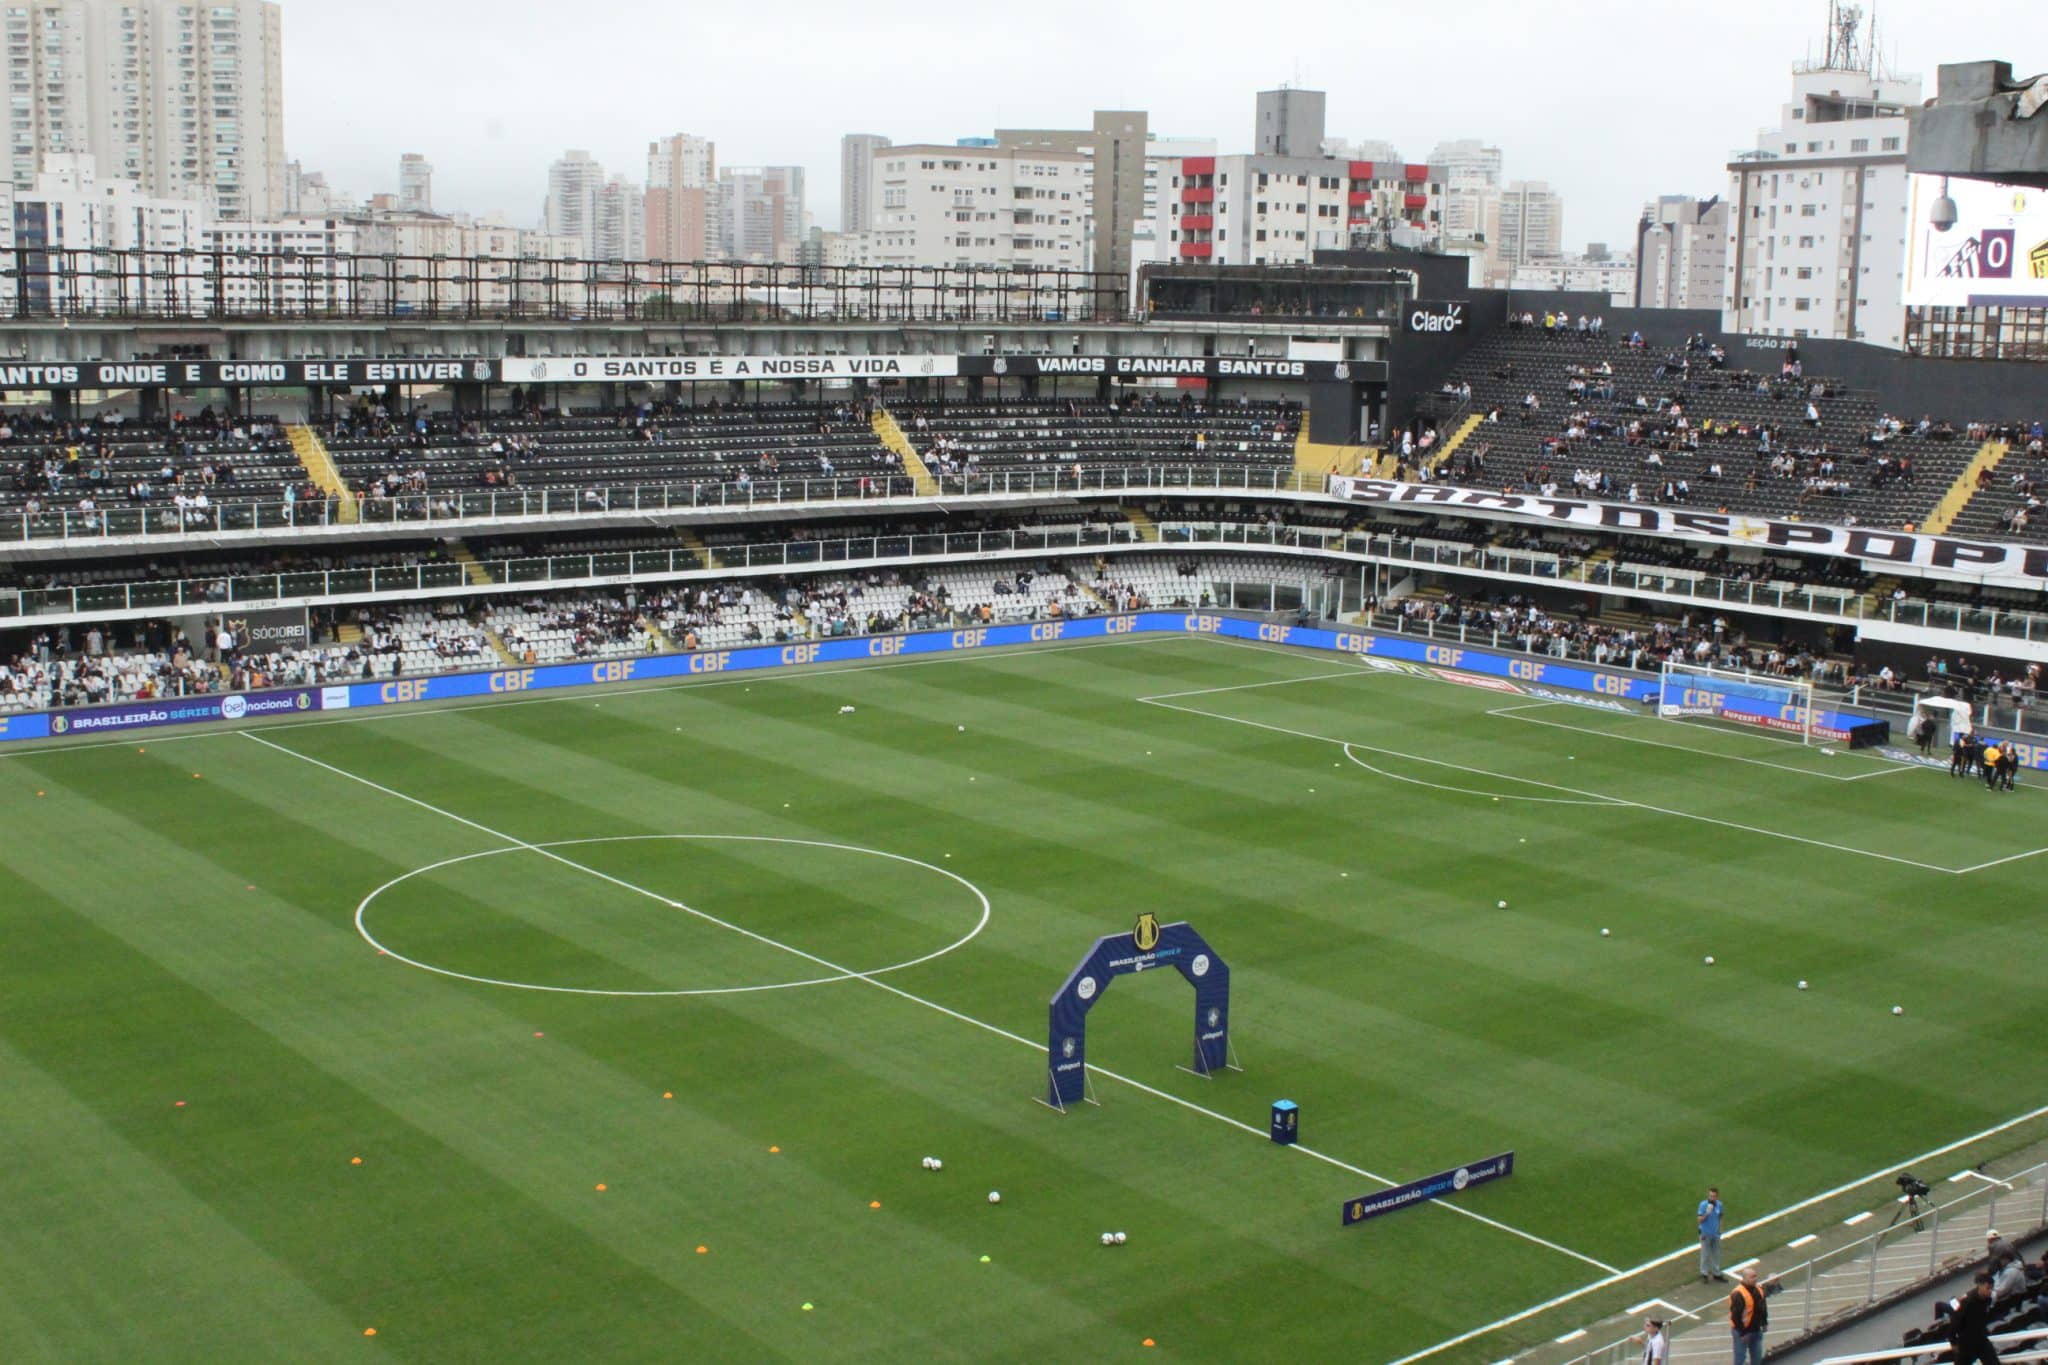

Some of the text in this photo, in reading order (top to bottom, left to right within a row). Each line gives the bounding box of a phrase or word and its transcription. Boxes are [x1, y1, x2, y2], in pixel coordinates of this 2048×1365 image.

[1987, 237, 2007, 268] 0
[1411, 310, 1455, 332] Claro
[100, 365, 166, 383] ONDE
[186, 365, 200, 382] E
[219, 364, 285, 381] COMO
[304, 364, 348, 381] ELE
[366, 363, 463, 380] ESTIVER
[574, 358, 900, 377] O SANTOS É A NOSSA VIDA
[1037, 358, 1304, 376] VAMOS GANHAR SANTOS
[1350, 479, 1731, 537] SANTOS
[252, 624, 304, 640] SÓCIOREI
[1031, 621, 1065, 641] CBF
[1106, 615, 1137, 634] CBF
[1185, 615, 1222, 633] CBF
[1259, 623, 1291, 643] CBF
[869, 636, 905, 657] CBF
[952, 629, 987, 649] CBF
[1336, 632, 1375, 653] CBF
[690, 651, 730, 673] CBF
[782, 643, 820, 664] CBF
[1426, 645, 1464, 667] CBF
[490, 669, 534, 692] CBF
[592, 660, 634, 683] CBF
[1509, 659, 1546, 682] CBF
[381, 680, 429, 703] CBF
[1593, 673, 1632, 697] CBF
[73, 711, 167, 729] BRASILEIRÃO
[170, 706, 209, 720] SÉRIE
[2015, 743, 2048, 768] BF
[1364, 1189, 1421, 1214] BRASILEIRÃO
